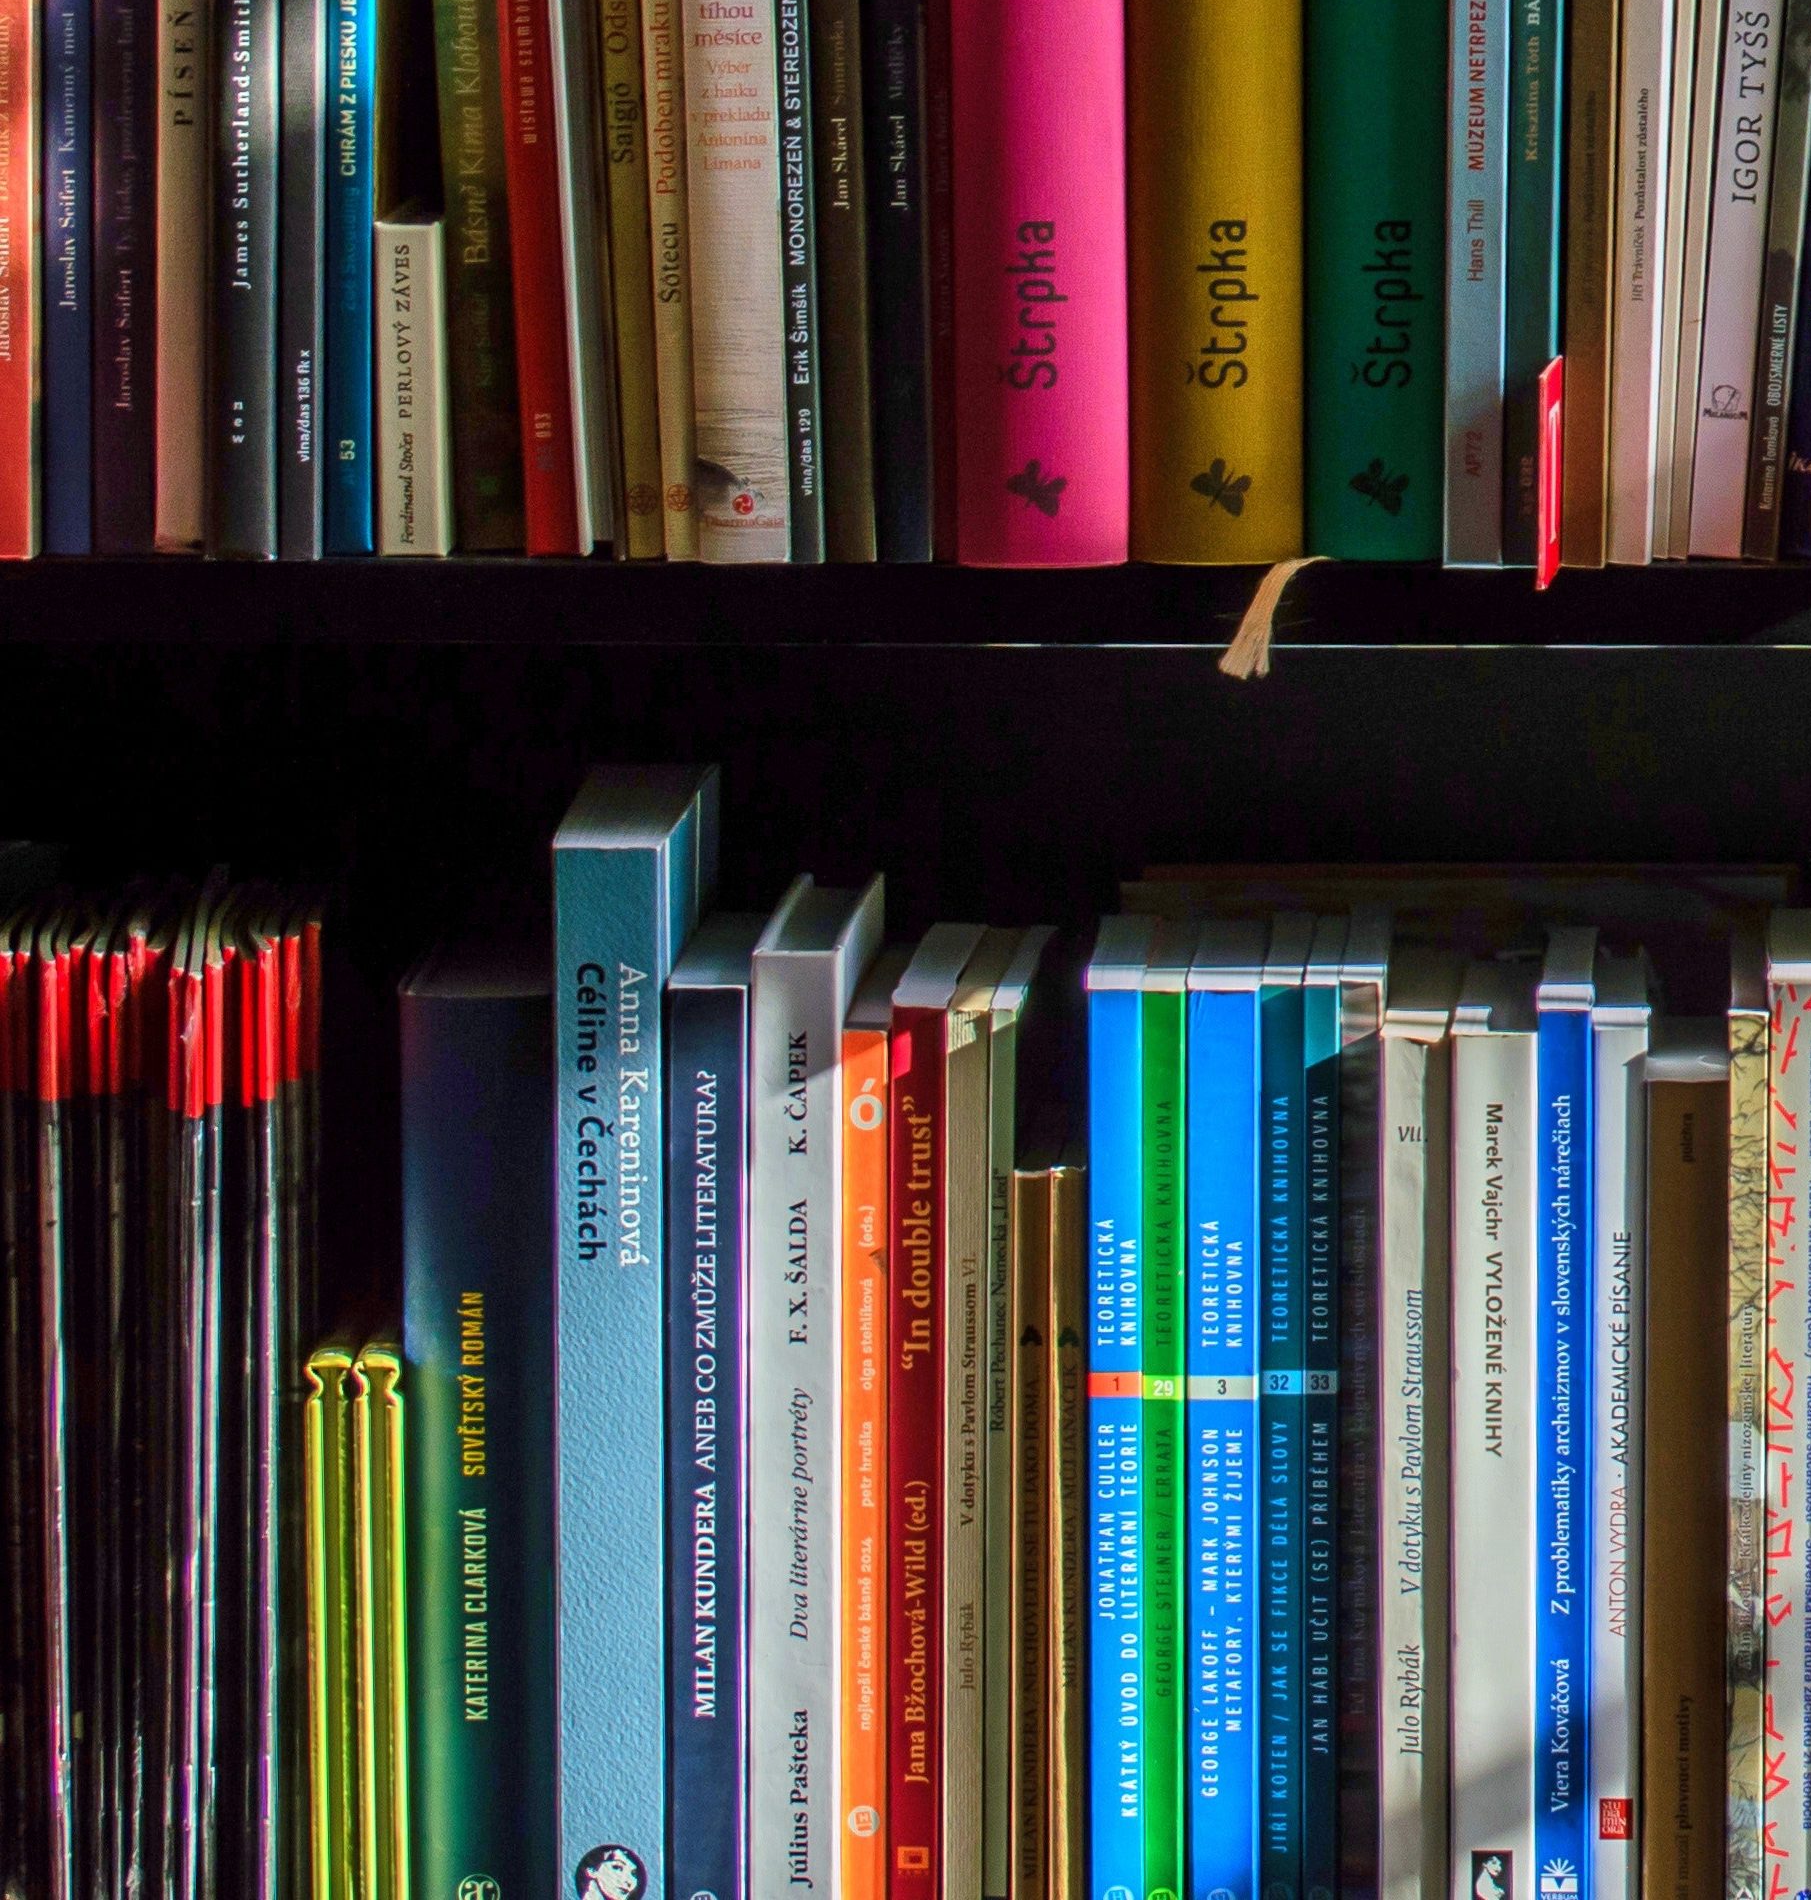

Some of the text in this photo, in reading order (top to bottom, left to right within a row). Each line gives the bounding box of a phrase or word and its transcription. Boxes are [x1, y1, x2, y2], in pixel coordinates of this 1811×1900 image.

[165, 7, 195, 127] PÍSEŇ
[1730, 11, 1771, 98] TYŠŠ
[784, 116, 803, 130] &
[1464, 89, 1488, 171] MÚZEUM
[1730, 109, 1762, 206] IGOR
[231, 219, 251, 289] James
[782, 137, 806, 266] MONOREZEŇ
[391, 243, 415, 419] PERLOVÝ ZÁVES
[787, 283, 810, 343] Šimšík
[790, 350, 811, 385] Erik
[1000, 219, 1068, 392] Štrpka
[1185, 218, 1260, 392] Štrpka
[1349, 219, 1426, 390] Štrpka
[617, 963, 648, 1265] Anna Kareninová
[901, 1200, 932, 1309] double
[1095, 1219, 1117, 1347] TEORETICKÁ
[1120, 1237, 1138, 1347] KNIHOVNA
[457, 1293, 489, 1722] KATERINA CLARKOVÁ SOVĚTSKÝ ROMÁN
[692, 1483, 718, 1718] MILAN KUNDERA
[786, 1709, 814, 1886] Július Pašteka
[1548, 1659, 1572, 1813] Viera Kováčová
